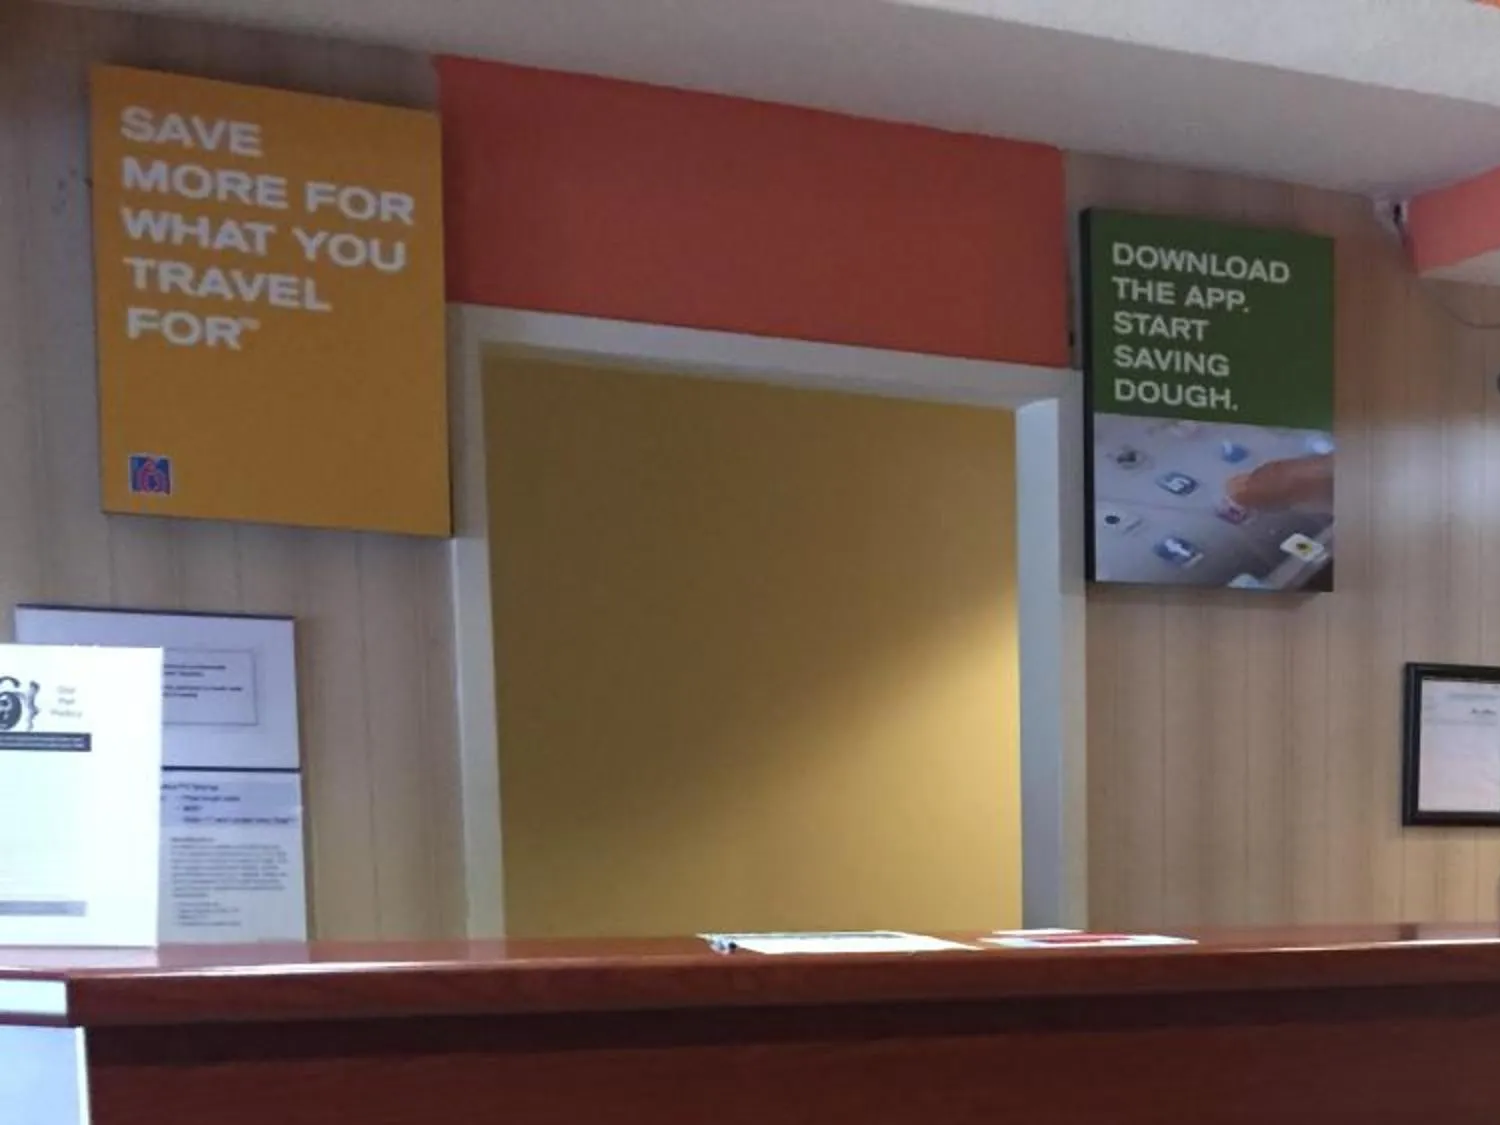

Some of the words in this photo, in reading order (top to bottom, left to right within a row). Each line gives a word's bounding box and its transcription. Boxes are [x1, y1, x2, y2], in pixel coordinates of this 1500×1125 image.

[120, 106, 263, 157] SAVE
[121, 156, 288, 210] MORE
[305, 182, 415, 225] FOR
[120, 207, 277, 256] WHAT
[292, 226, 406, 273] YOU
[1112, 242, 1291, 284] DOWNLOAD
[123, 257, 332, 312] TRAVEL
[1112, 276, 1175, 305] THE
[1184, 286, 1251, 313] APP.
[126, 307, 242, 350] FOR
[1113, 311, 1210, 341] START
[1113, 345, 1231, 377] SAVING
[1114, 379, 1240, 412] DOUGH.
